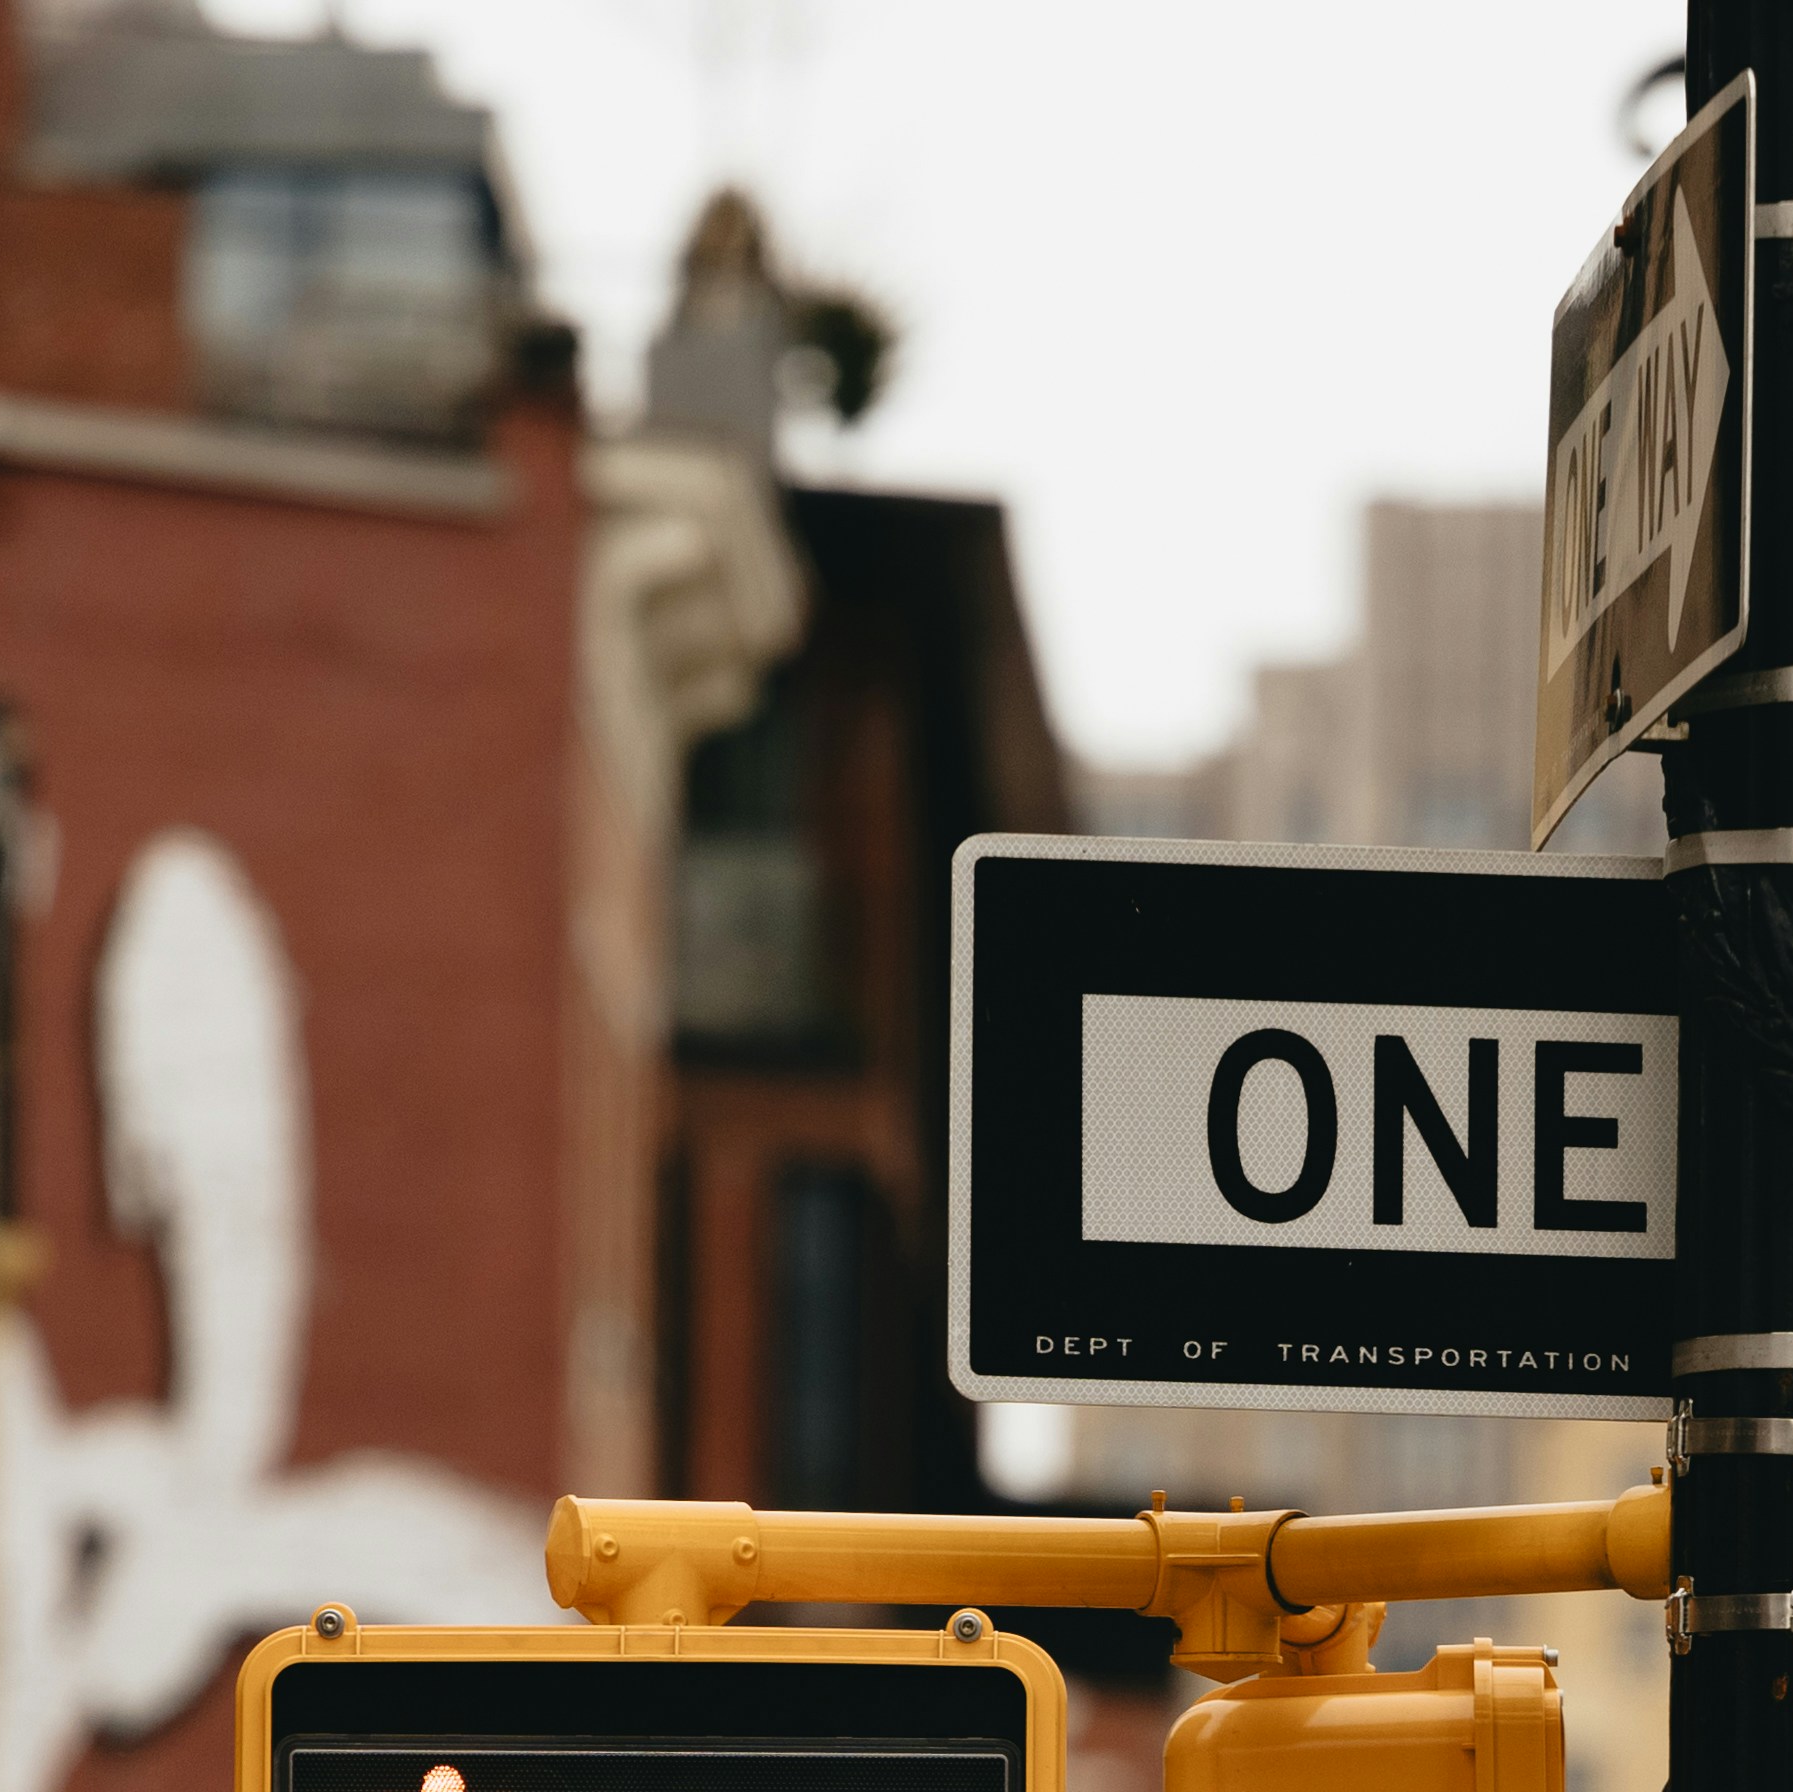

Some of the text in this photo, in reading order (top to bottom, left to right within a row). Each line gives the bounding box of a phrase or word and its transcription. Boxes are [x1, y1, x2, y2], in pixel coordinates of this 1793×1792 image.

[1561, 398, 1613, 640] ONE
[1637, 301, 1705, 556] WAY
[1208, 1027, 1649, 1234] ONE
[1034, 1335, 1630, 1372] DEPT OF TRANSPORTATION
